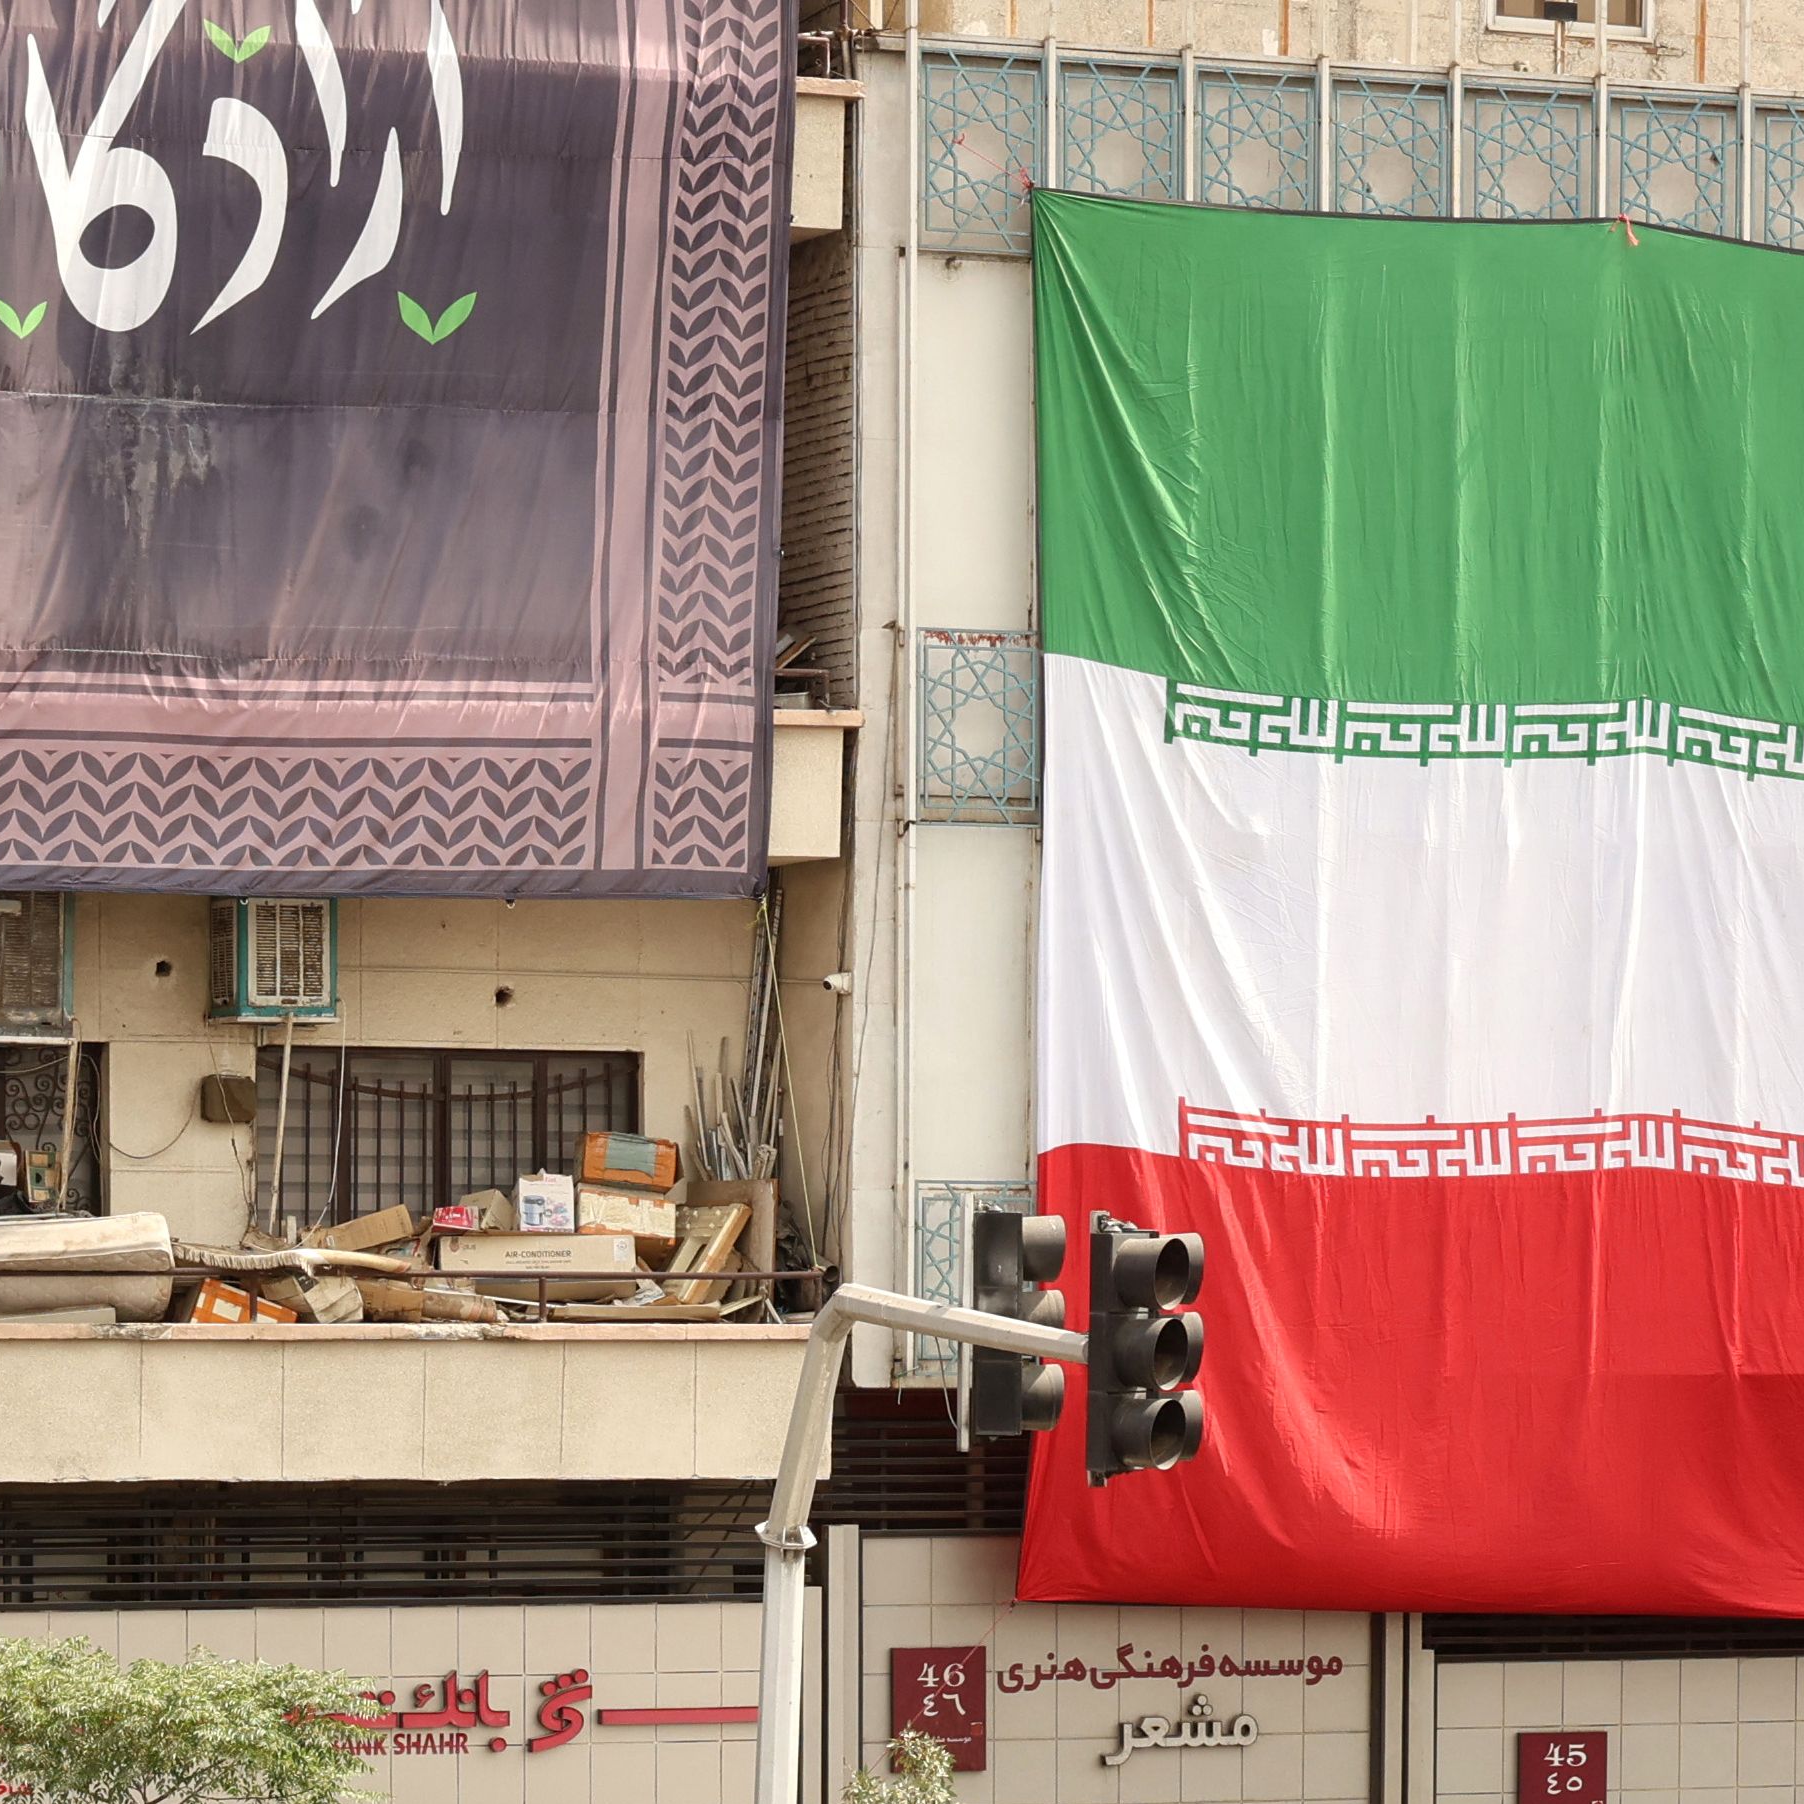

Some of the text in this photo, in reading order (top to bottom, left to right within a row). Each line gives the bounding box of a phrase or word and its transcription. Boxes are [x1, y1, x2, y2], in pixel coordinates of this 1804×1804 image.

[917, 1663, 966, 1688] 46
[997, 1652, 1089, 1693] هنری
[1090, 1643, 1217, 1690] فرهنگی
[393, 1733, 470, 1755] SHAHR
[1100, 1693, 1260, 1767] مشعر
[1543, 1743, 1587, 1768] 45
